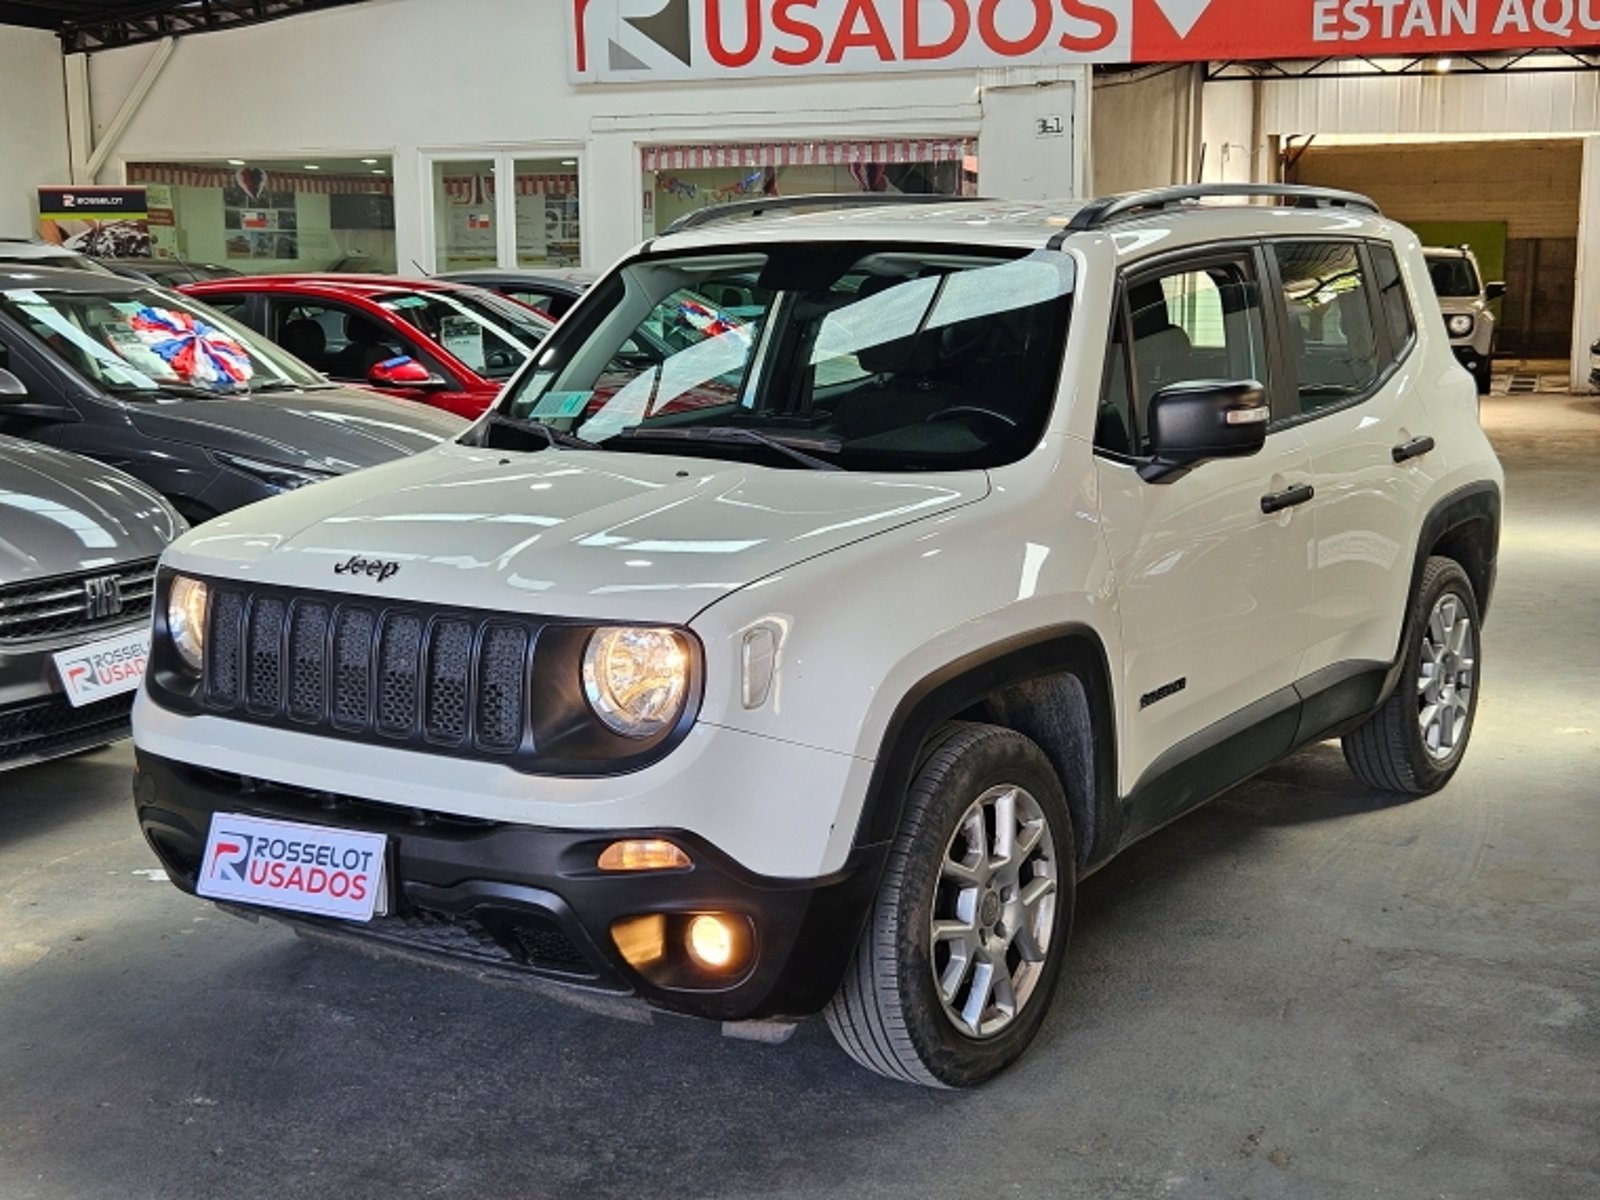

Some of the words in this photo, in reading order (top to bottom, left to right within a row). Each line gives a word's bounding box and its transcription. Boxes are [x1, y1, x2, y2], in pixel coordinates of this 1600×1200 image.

[704, 0, 1118, 68] USADOS
[334, 553, 399, 582] Jeep
[254, 837, 373, 872] ROSSELOT
[249, 860, 368, 900] USADOS
